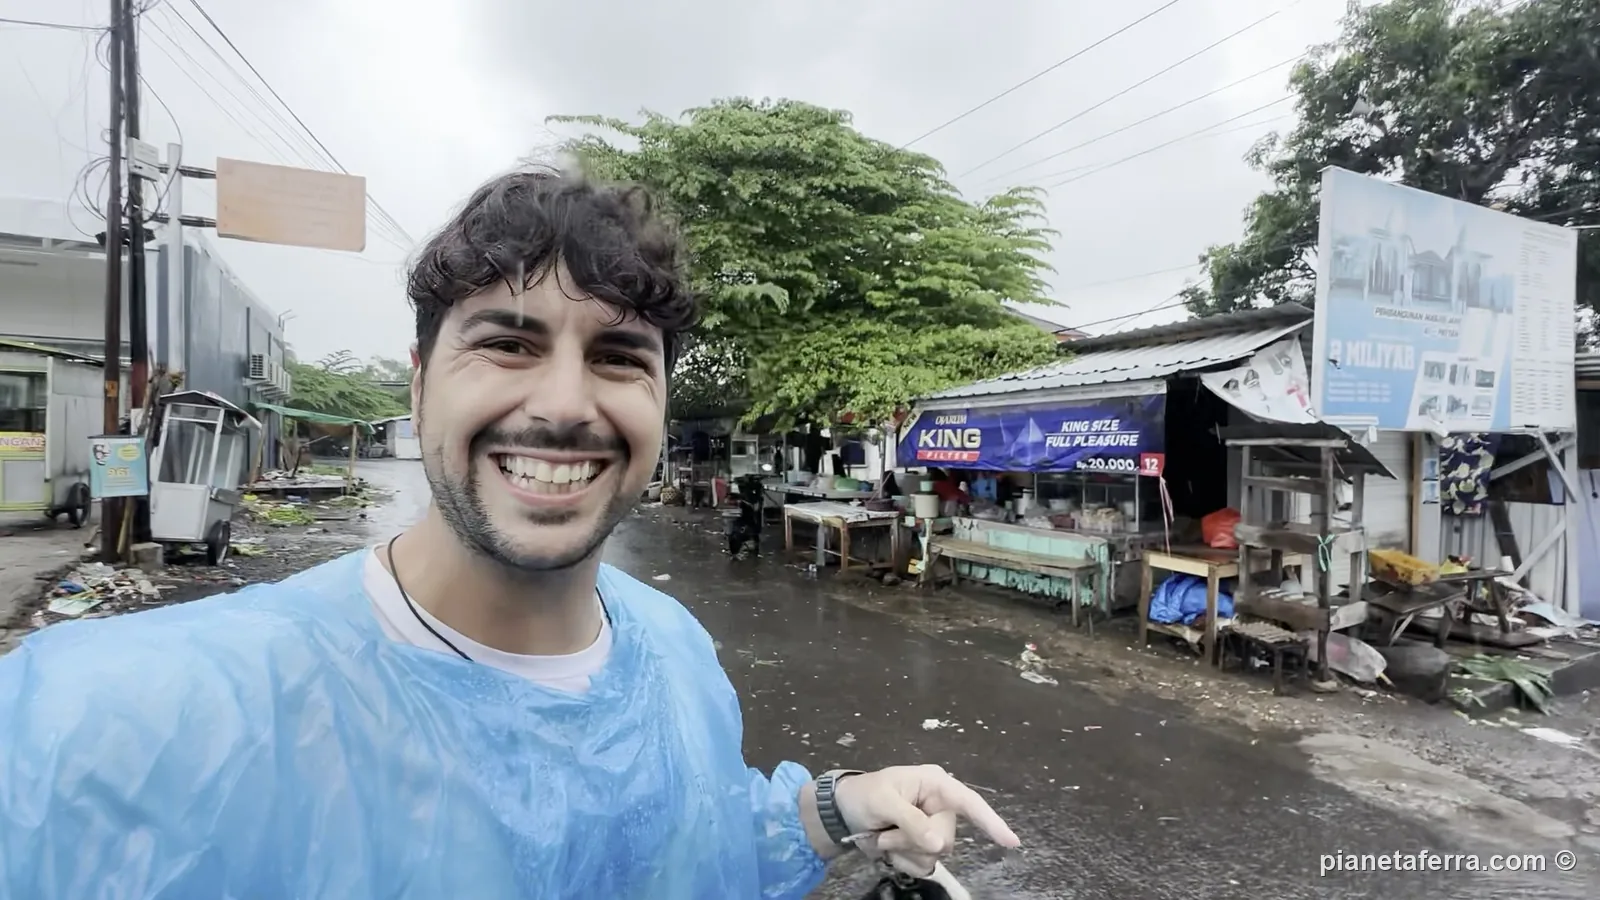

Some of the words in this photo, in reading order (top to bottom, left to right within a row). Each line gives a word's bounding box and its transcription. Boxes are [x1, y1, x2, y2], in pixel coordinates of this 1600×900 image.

[1062, 421, 1090, 432] KING
[1091, 420, 1120, 432] SIZE
[919, 428, 981, 449] KING
[1046, 436, 1071, 447] FULL
[1073, 434, 1139, 447] PLEASURE
[926, 451, 969, 461] FILTER
[1144, 458, 1158, 471] 12
